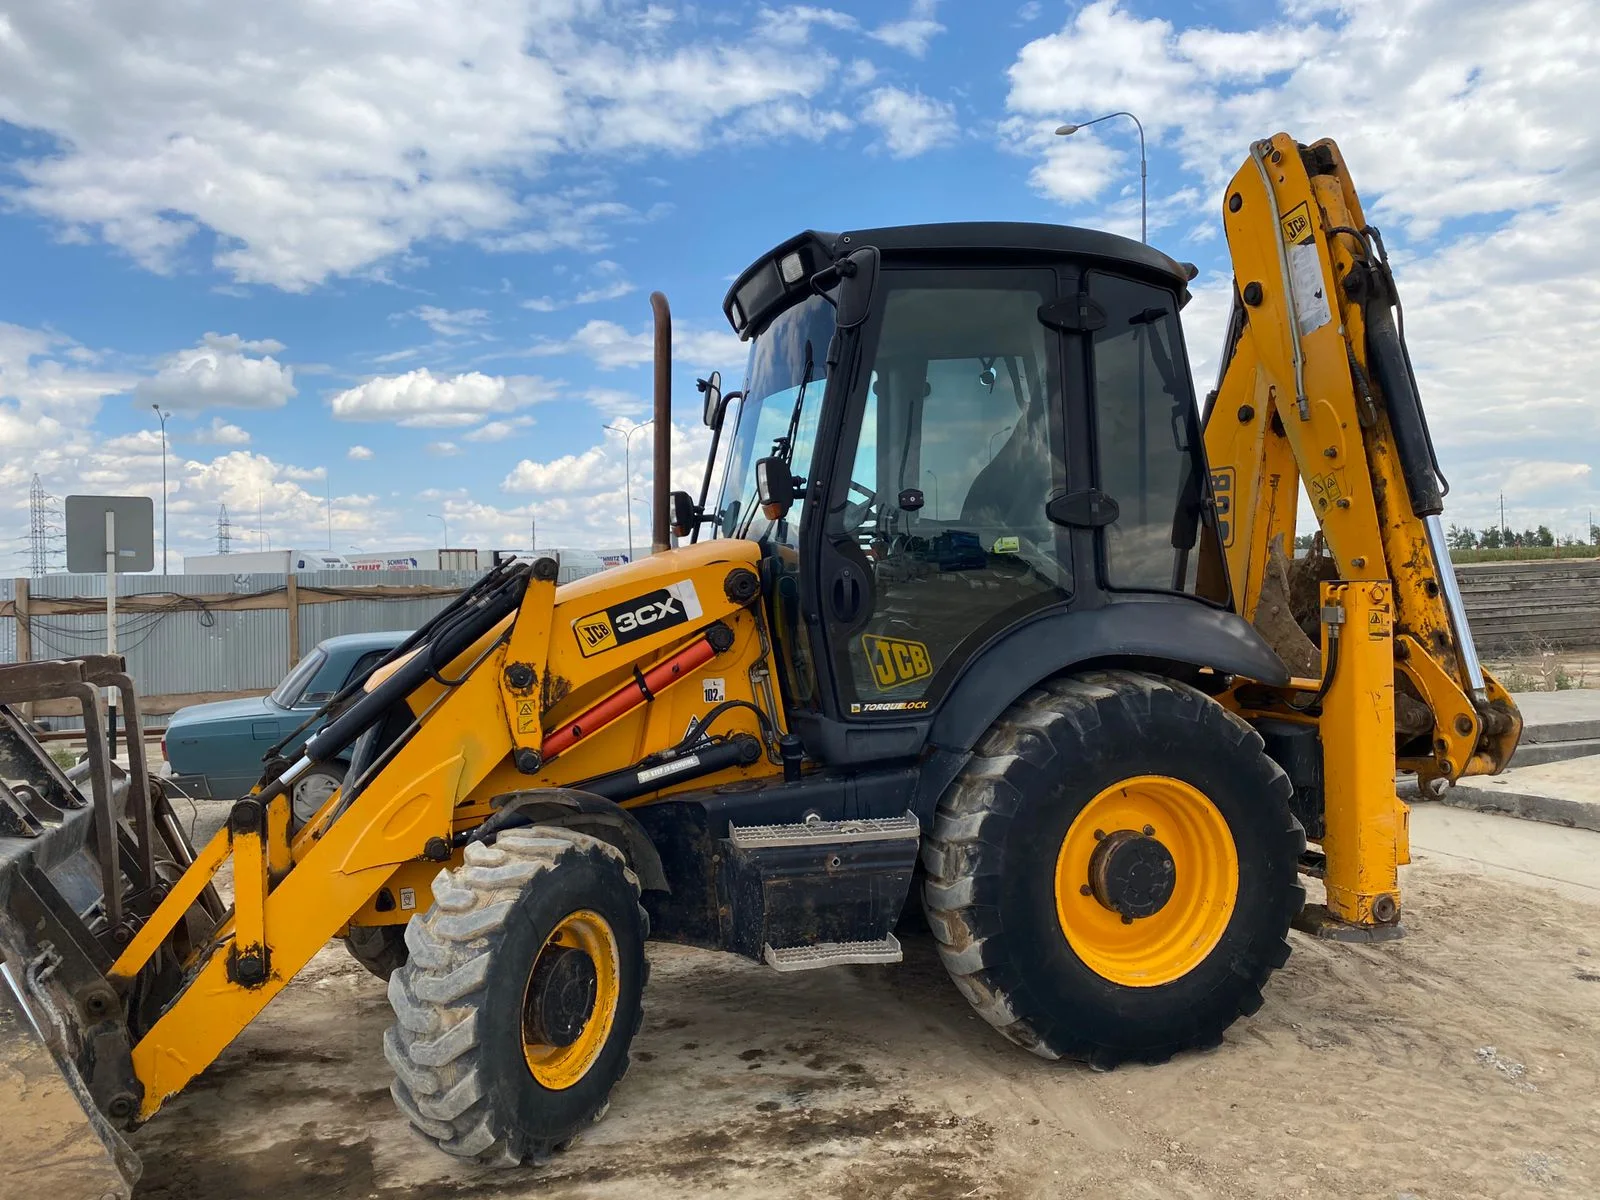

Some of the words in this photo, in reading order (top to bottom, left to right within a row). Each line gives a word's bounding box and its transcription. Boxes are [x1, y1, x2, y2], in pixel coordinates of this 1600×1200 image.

[1287, 217, 1306, 239] JCB
[583, 624, 609, 645] JCB
[615, 597, 680, 633] 3CX
[875, 640, 929, 685] JCB
[704, 688, 719, 702] 102
[863, 701, 929, 712] TORQUELOCK
